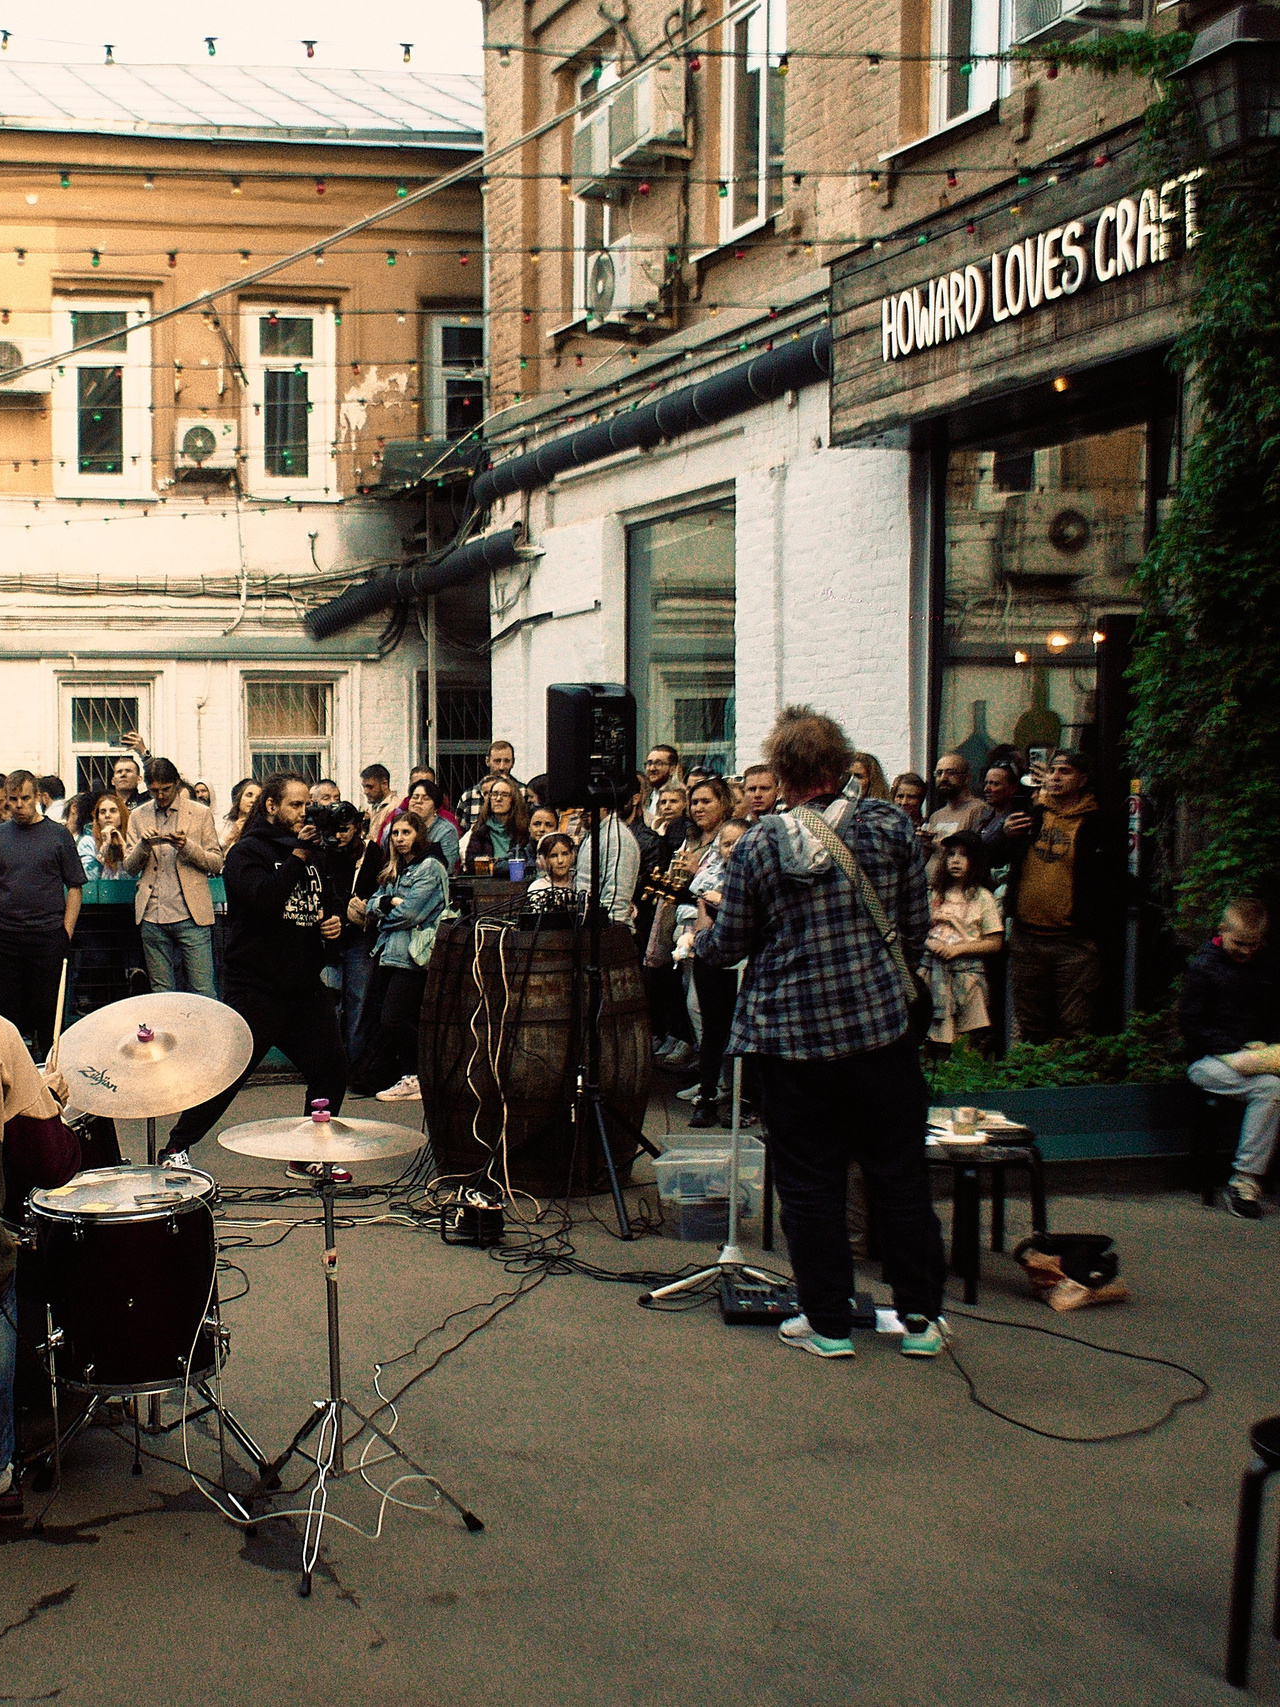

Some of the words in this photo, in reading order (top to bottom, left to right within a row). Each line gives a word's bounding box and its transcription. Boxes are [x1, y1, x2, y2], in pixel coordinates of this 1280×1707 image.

[882, 264, 984, 362] HOWARD
[991, 221, 1087, 323] LOVES
[1095, 167, 1208, 283] CRAFT
